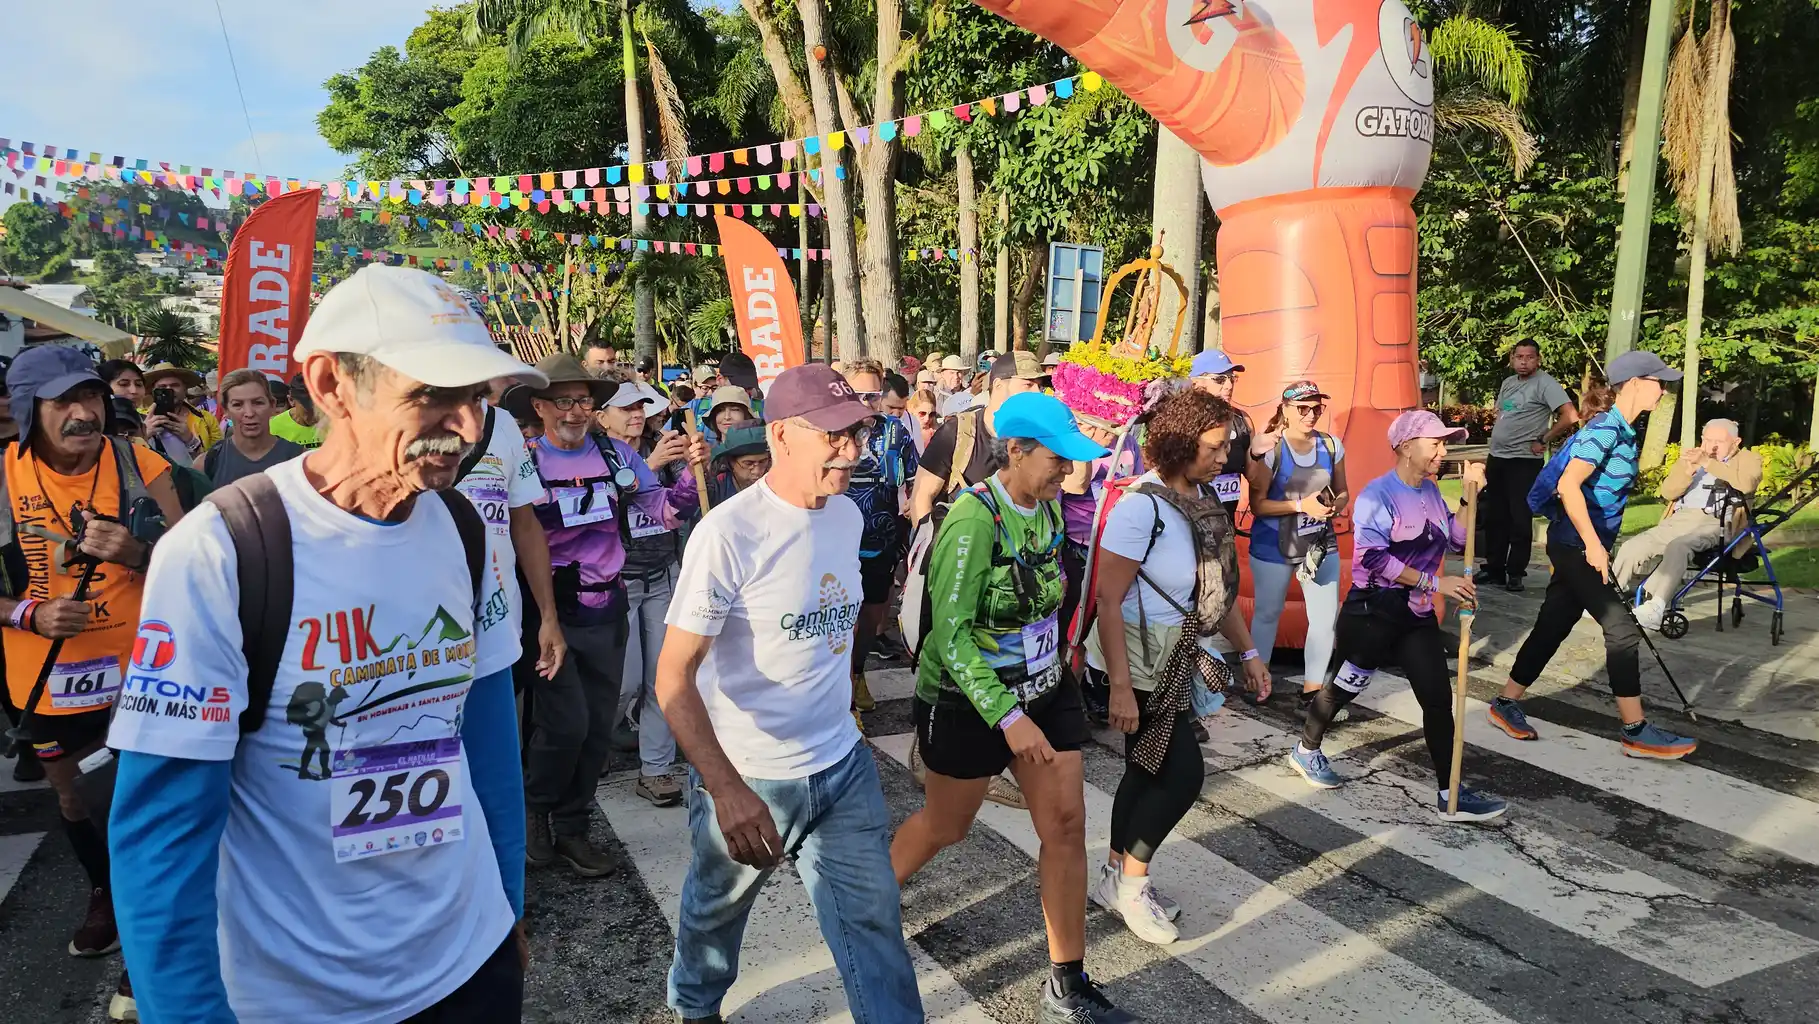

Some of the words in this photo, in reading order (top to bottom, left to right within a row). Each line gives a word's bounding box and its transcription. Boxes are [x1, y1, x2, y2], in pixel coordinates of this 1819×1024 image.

[247, 240, 290, 382] RADE
[828, 381, 853, 396] 36
[477, 502, 505, 521] 06
[298, 603, 383, 671] 24K
[1035, 628, 1054, 661] 78
[329, 652, 418, 688] CAMINATA
[421, 649, 441, 667] DE
[64, 671, 106, 696] 161
[163, 700, 198, 721] MÁS
[201, 706, 231, 722] VIDA
[369, 703, 410, 719] HOMENAJE
[340, 768, 450, 828] 250
